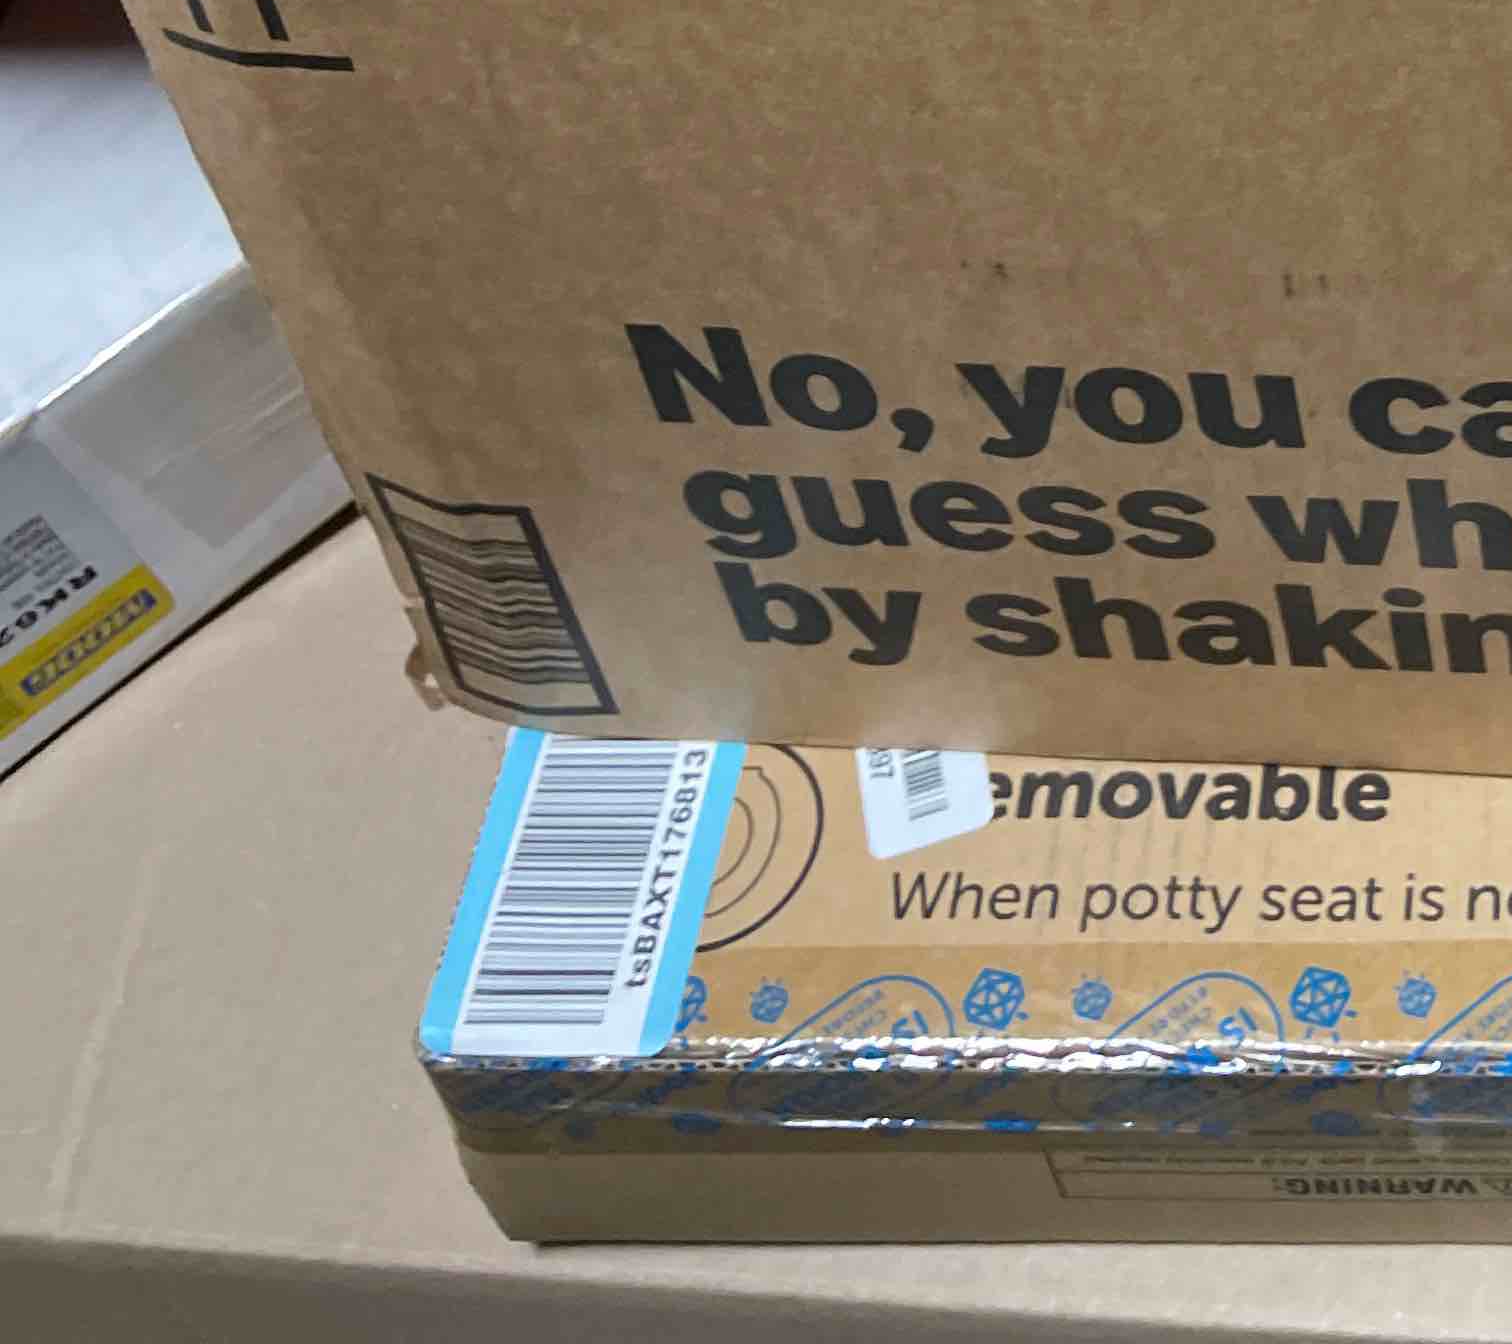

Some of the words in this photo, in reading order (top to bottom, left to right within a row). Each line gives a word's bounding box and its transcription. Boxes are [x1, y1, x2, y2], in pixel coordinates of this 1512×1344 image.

[623, 322, 936, 454] No,
[955, 362, 1307, 459] you
[682, 466, 1218, 562] guess
[714, 560, 923, 668] by
[987, 762, 1391, 822] emovable
[891, 869, 1061, 923] When
[1079, 873, 1244, 936] potty
[1259, 875, 1384, 923] seat
[1402, 872, 1446, 923] is
